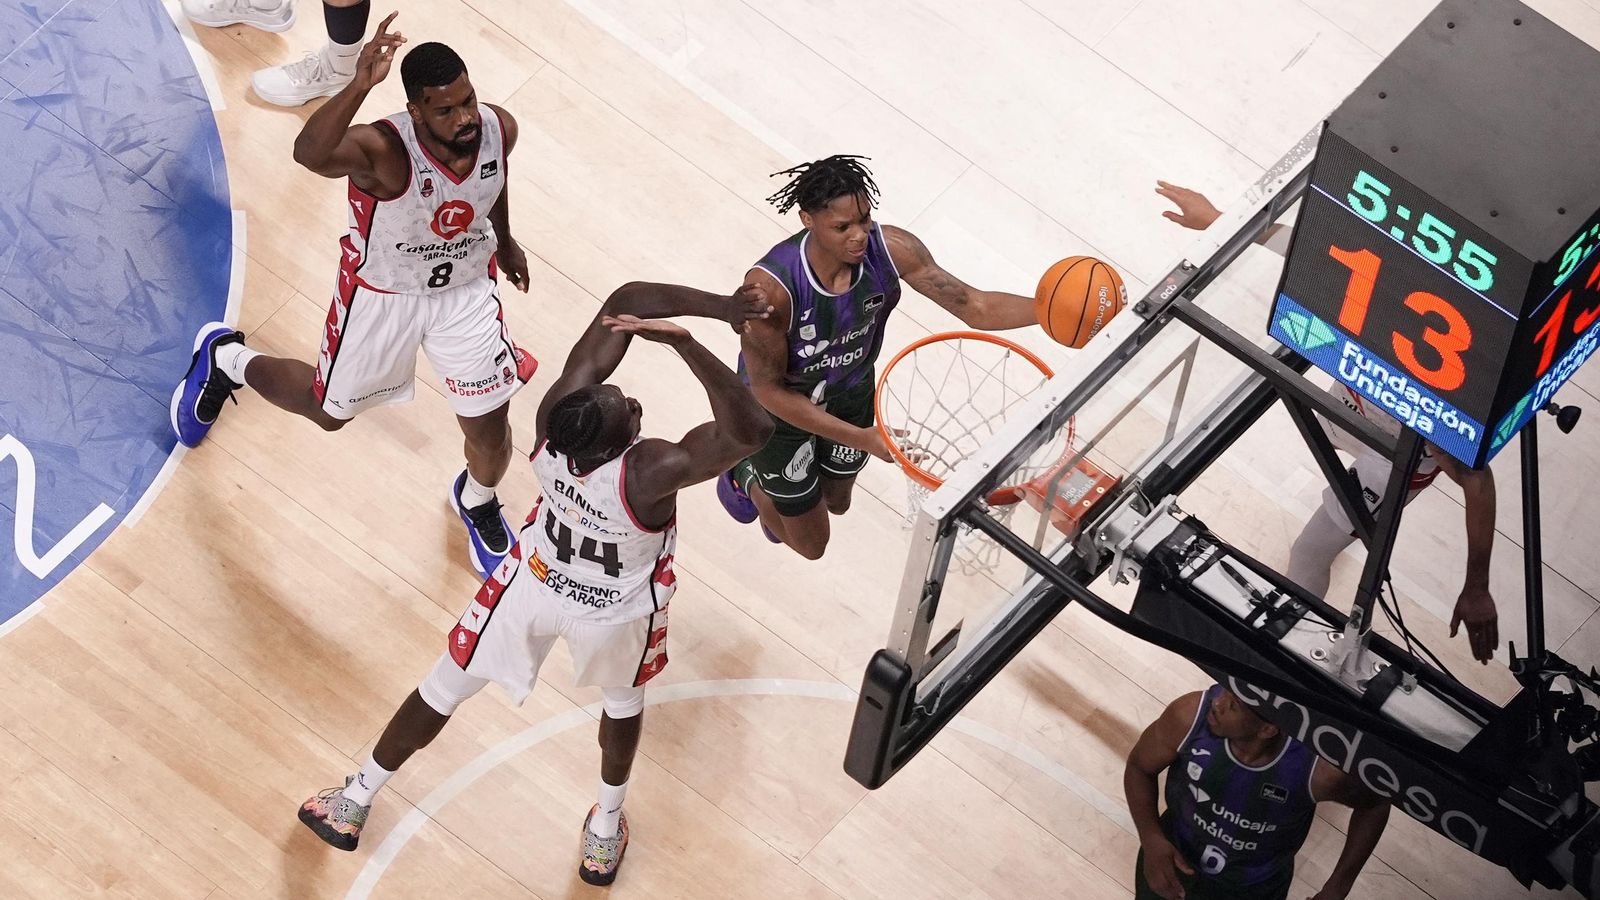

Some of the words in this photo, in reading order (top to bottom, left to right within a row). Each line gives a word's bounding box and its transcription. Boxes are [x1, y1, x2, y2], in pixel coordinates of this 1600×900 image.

[1347, 170, 1498, 291] 5:55
[1553, 223, 1600, 286] 5:
[427, 261, 453, 288] 8
[1328, 244, 1473, 392] 13
[1338, 358, 1435, 434] Unicaja
[1342, 340, 1476, 442] Fundación
[544, 507, 624, 579] 44
[545, 576, 564, 594] DE
[566, 589, 622, 609] ARAGO
[1227, 676, 1488, 855] endesa
[1211, 802, 1277, 835] Unicaja
[1201, 844, 1228, 876] 6
